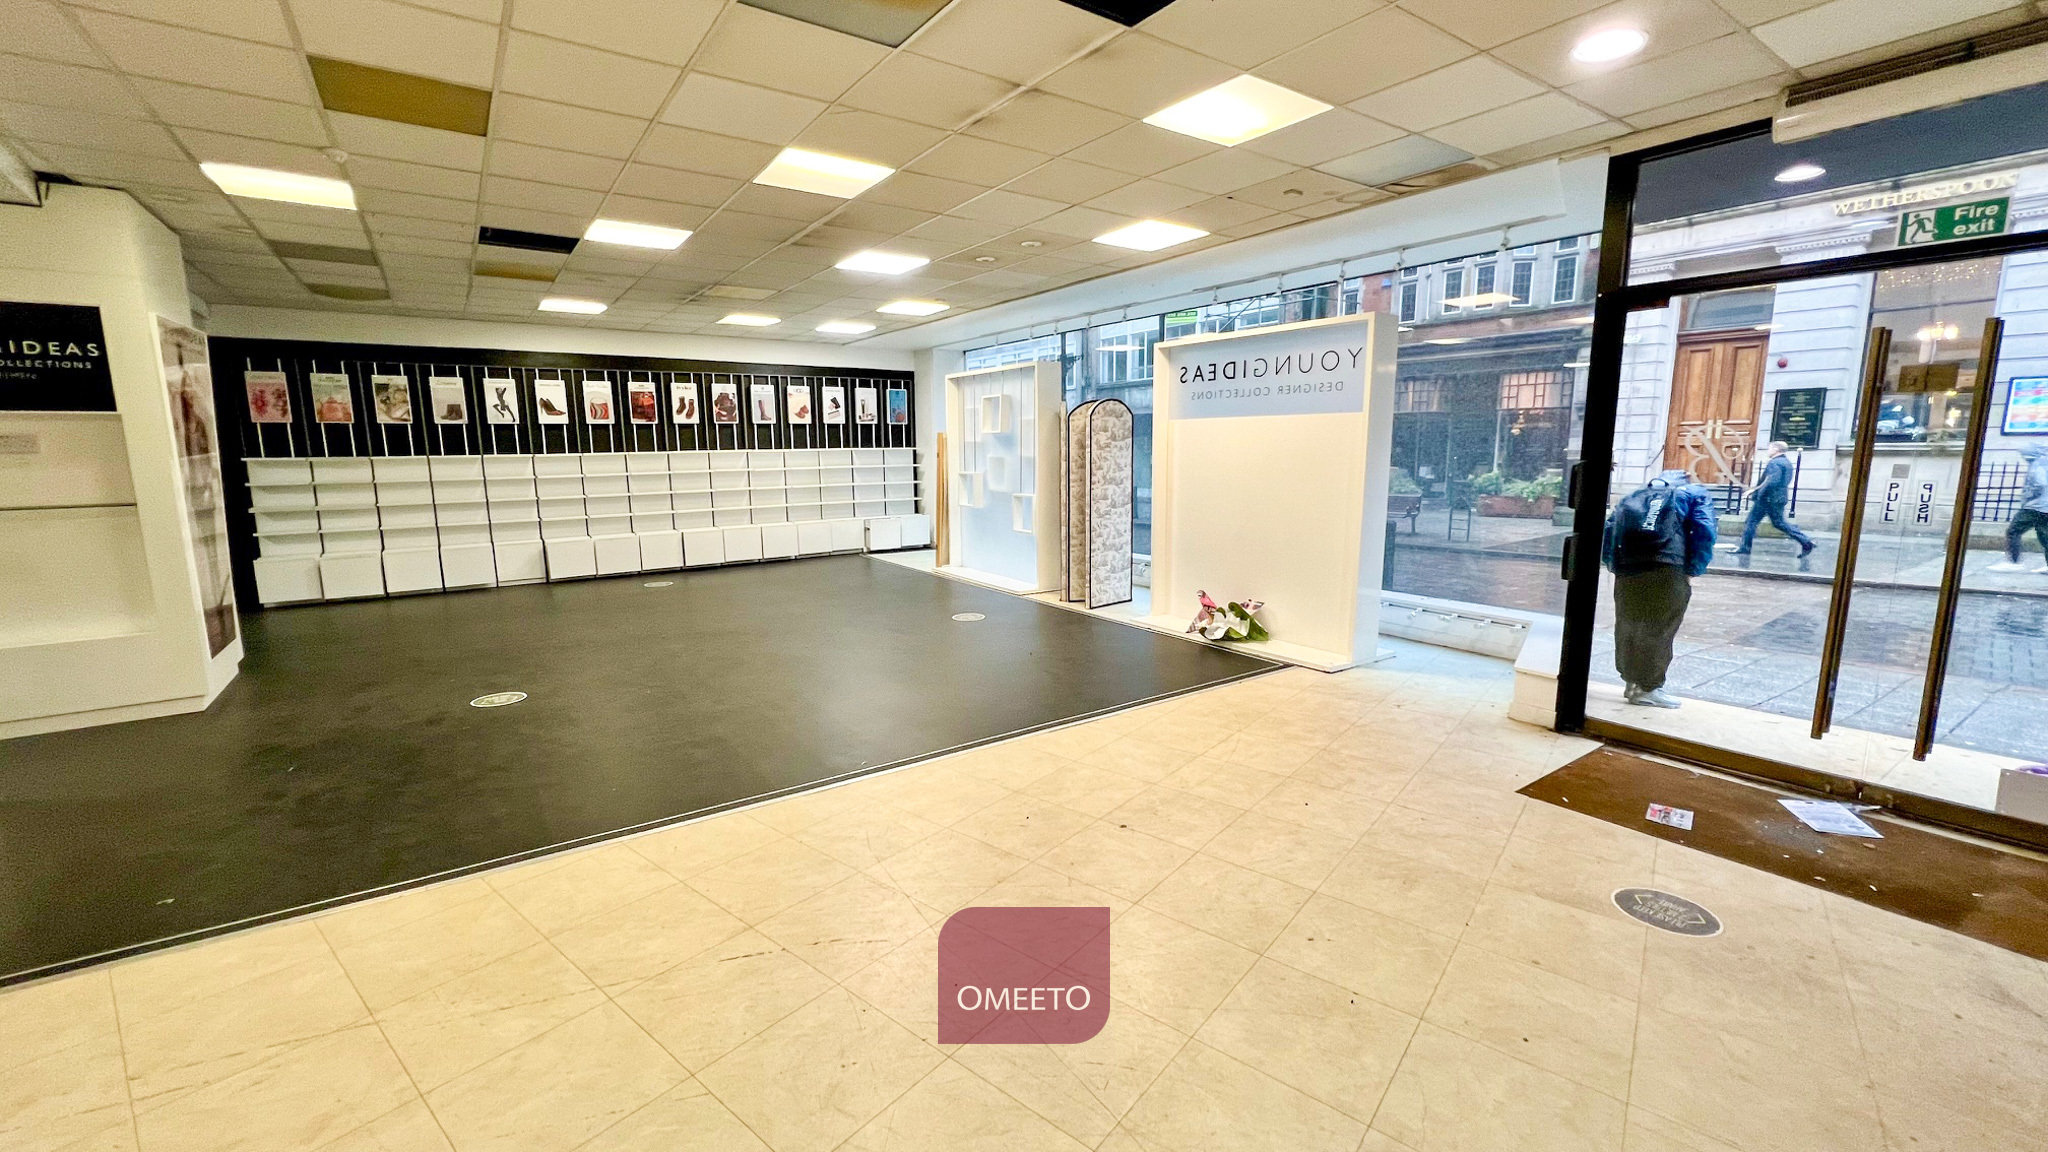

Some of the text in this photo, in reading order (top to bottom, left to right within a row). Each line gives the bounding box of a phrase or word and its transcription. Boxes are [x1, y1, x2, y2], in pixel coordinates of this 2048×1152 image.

[1833, 173, 2020, 217] WETHERSPOON
[1954, 204, 1999, 221] Fire
[1953, 218, 1995, 235] exit
[0, 339, 100, 357] IDEAS
[1884, 482, 1900, 522] PULL
